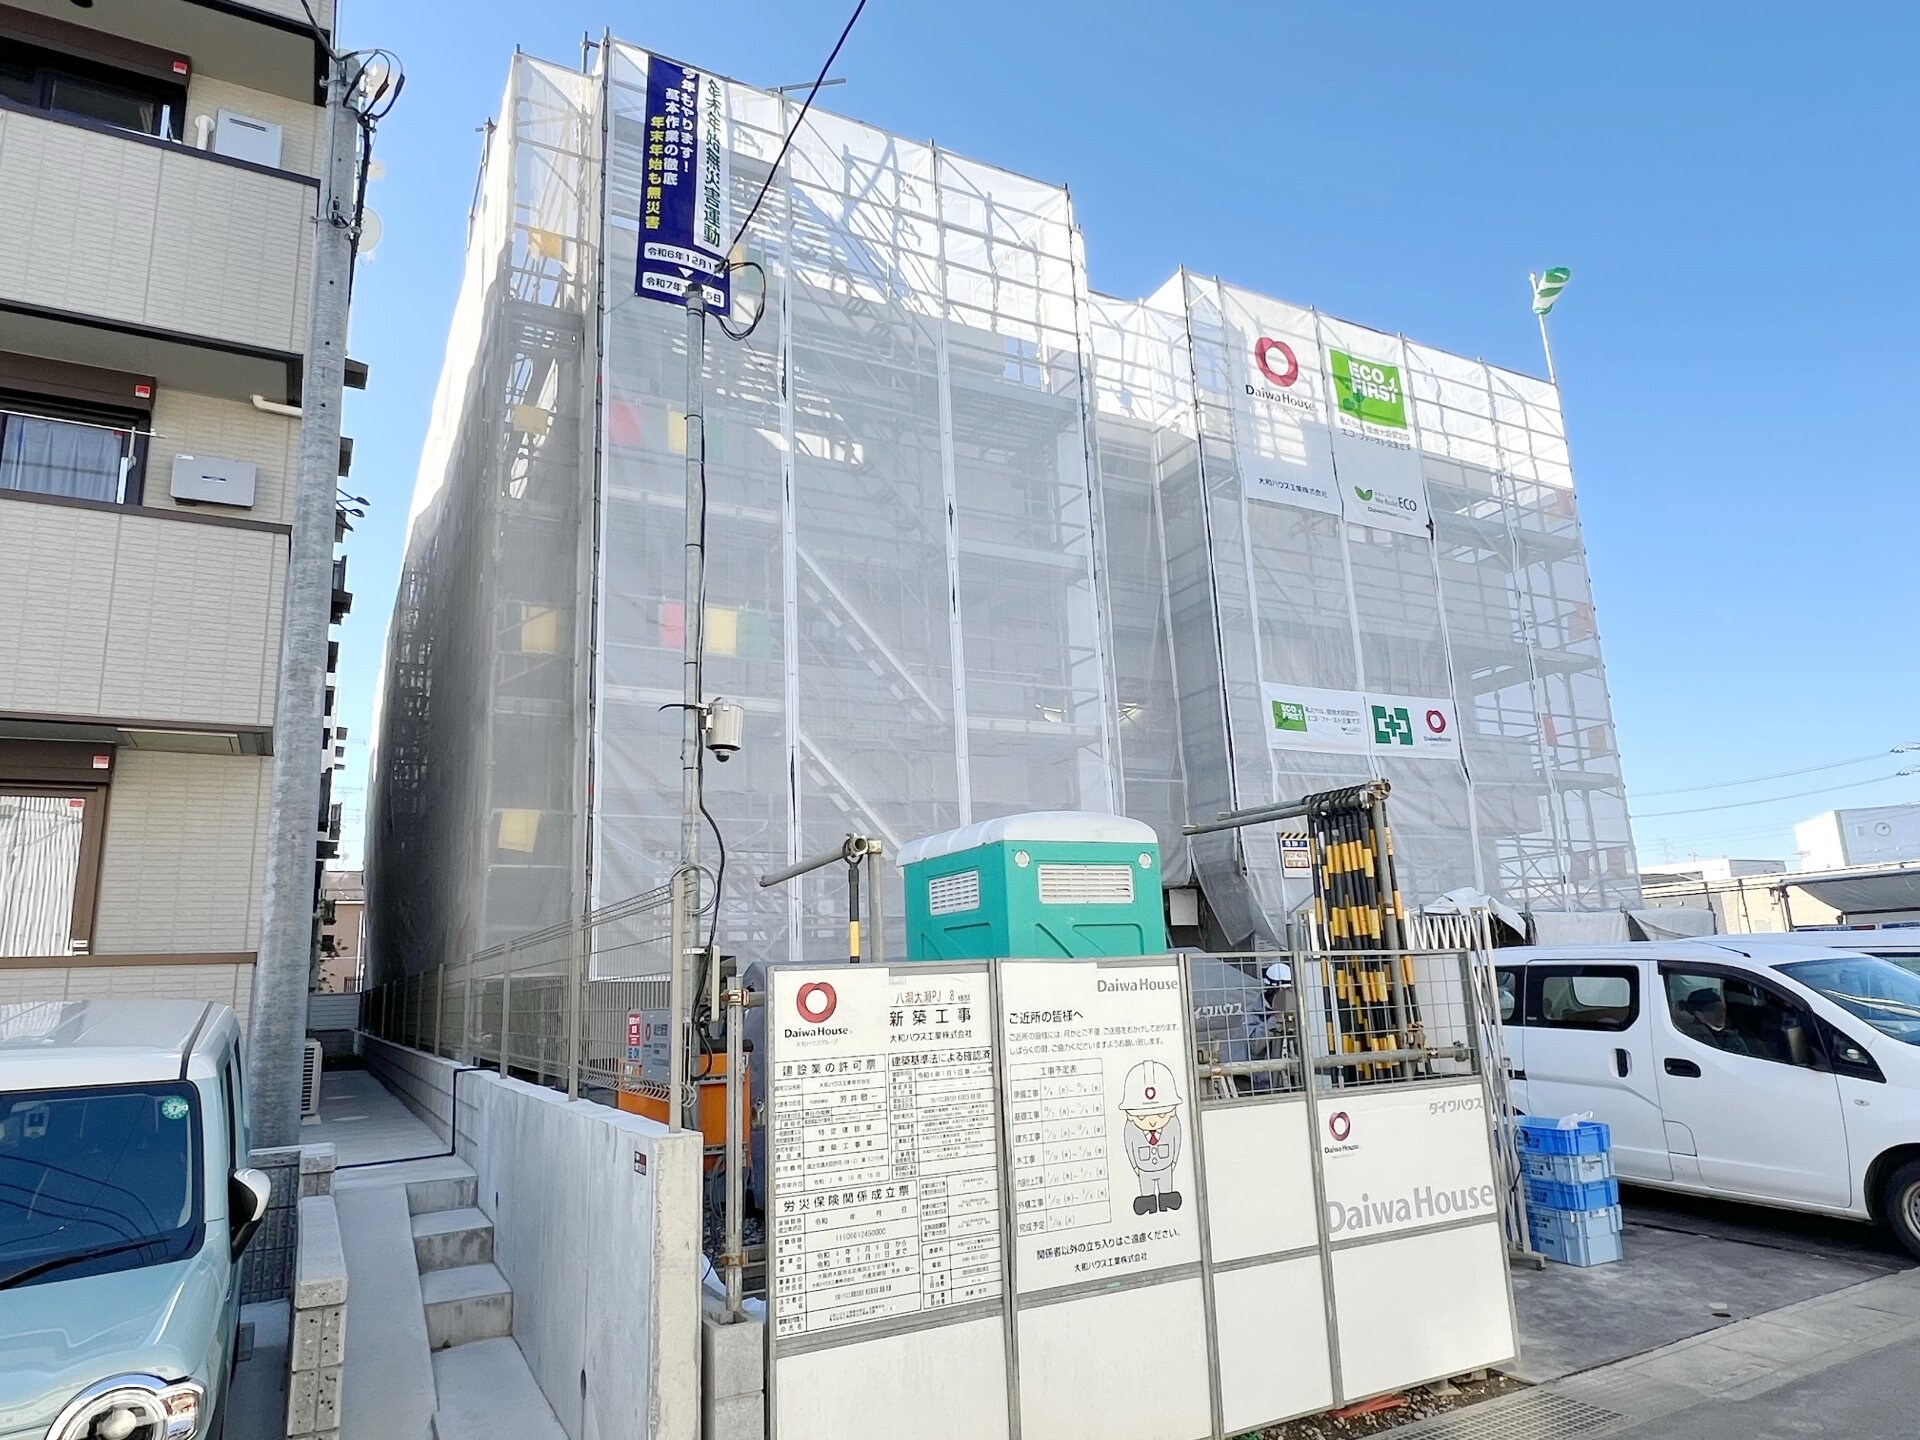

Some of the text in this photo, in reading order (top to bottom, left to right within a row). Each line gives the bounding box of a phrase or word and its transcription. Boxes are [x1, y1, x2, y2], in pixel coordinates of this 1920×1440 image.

[663, 88, 680, 186] 基本作業の徹底
[645, 116, 665, 230] 年末年始も無災害
[704, 79, 721, 248] 年末年始無災害運動
[648, 247, 718, 271] 令和6年12月1
[1348, 360, 1384, 384] ECO
[1351, 377, 1398, 403] FIRST
[1258, 477, 1328, 498] 大和ハウス工業株式会社
[1398, 497, 1417, 511] ECO
[1281, 704, 1296, 713] ECO
[1097, 978, 1178, 992] Daiwa House
[890, 1007, 971, 1027] 新築工事
[1009, 1010, 1084, 1024] ご近所の皆様へ
[784, 1026, 848, 1038] Daiwa House
[890, 1030, 972, 1043] 大和ハウス工業株式会社
[783, 1059, 876, 1077] 建設業の許可票
[1040, 1065, 1077, 1075] 工事予定表
[1429, 1097, 1484, 1115] ダイワハウス
[1016, 1155, 1035, 1164] 木工事
[1324, 1146, 1342, 1154] Daiwa
[783, 1184, 910, 1213] 労災保険関係成立票
[1327, 1184, 1495, 1234] Daiwa House
[1019, 1221, 1045, 1232] 完成予定
[1037, 1229, 1181, 1260] 関係者以外の立ち入りはご遠慮ください。
[1074, 1252, 1148, 1272] 大和ハウス工業株式会社
